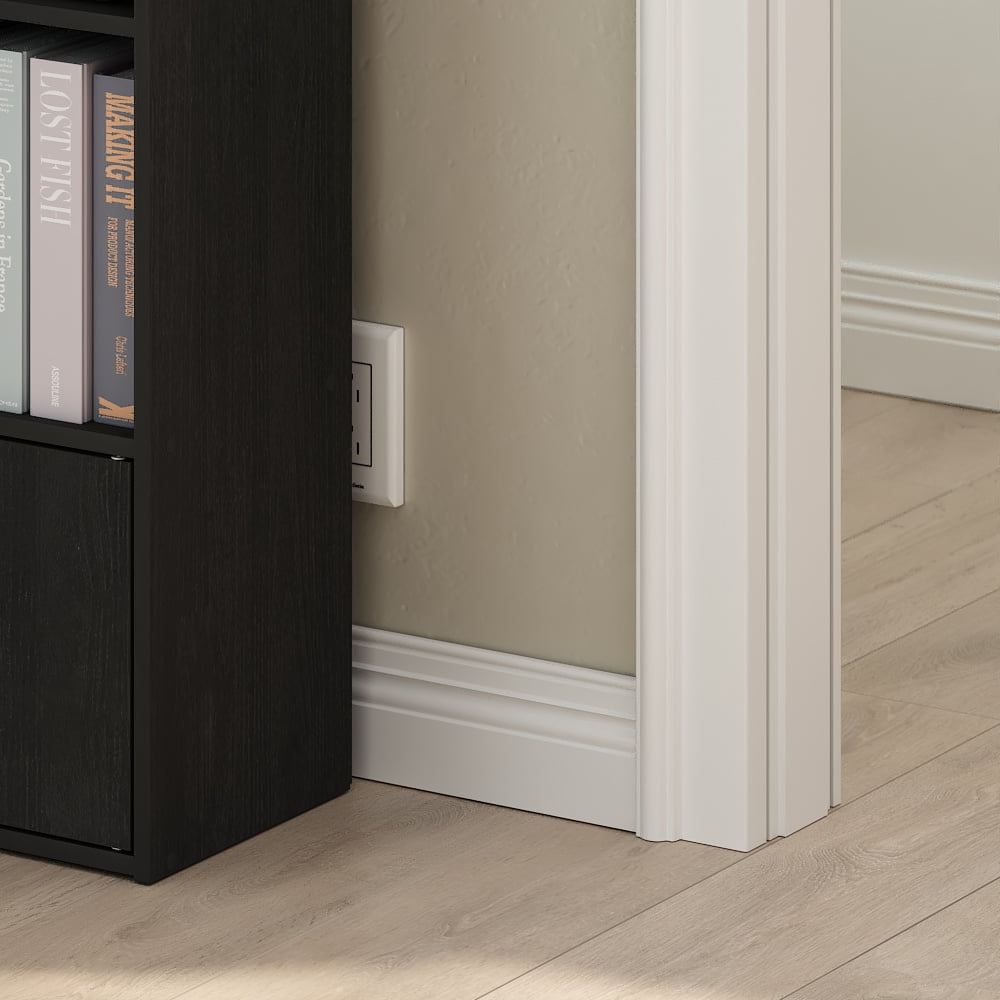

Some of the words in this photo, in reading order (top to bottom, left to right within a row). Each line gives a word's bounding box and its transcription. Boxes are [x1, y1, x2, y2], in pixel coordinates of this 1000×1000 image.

[39, 71, 73, 152] LOST
[104, 91, 134, 181] MAKING
[39, 157, 72, 226] FISH
[104, 184, 134, 210] IT
